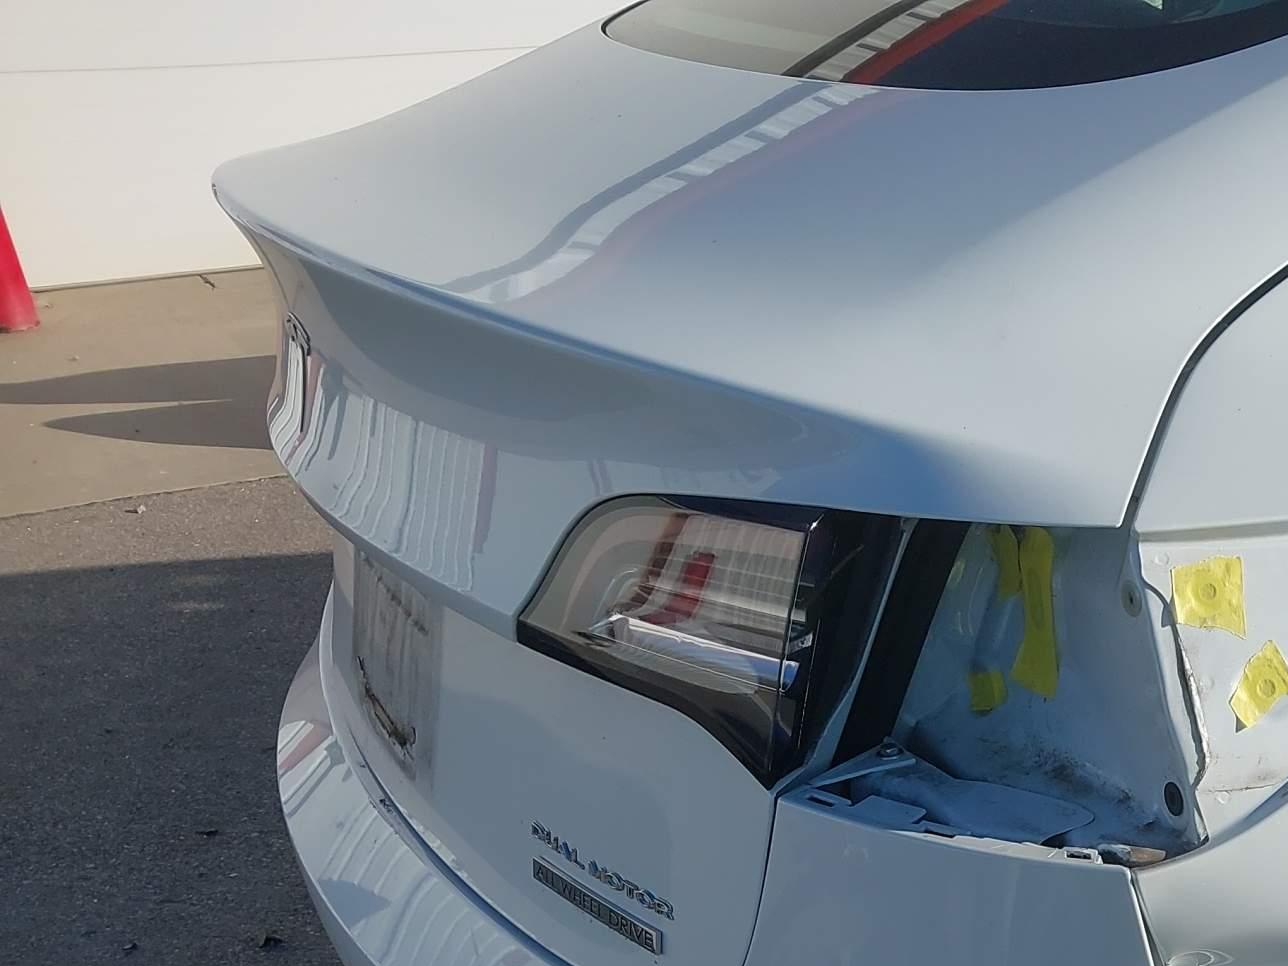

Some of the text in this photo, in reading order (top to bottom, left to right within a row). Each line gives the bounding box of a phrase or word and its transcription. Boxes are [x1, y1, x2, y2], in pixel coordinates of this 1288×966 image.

[535, 865, 655, 950] ALL WHEEL DRIVE
[588, 859, 675, 921] MOTOR
